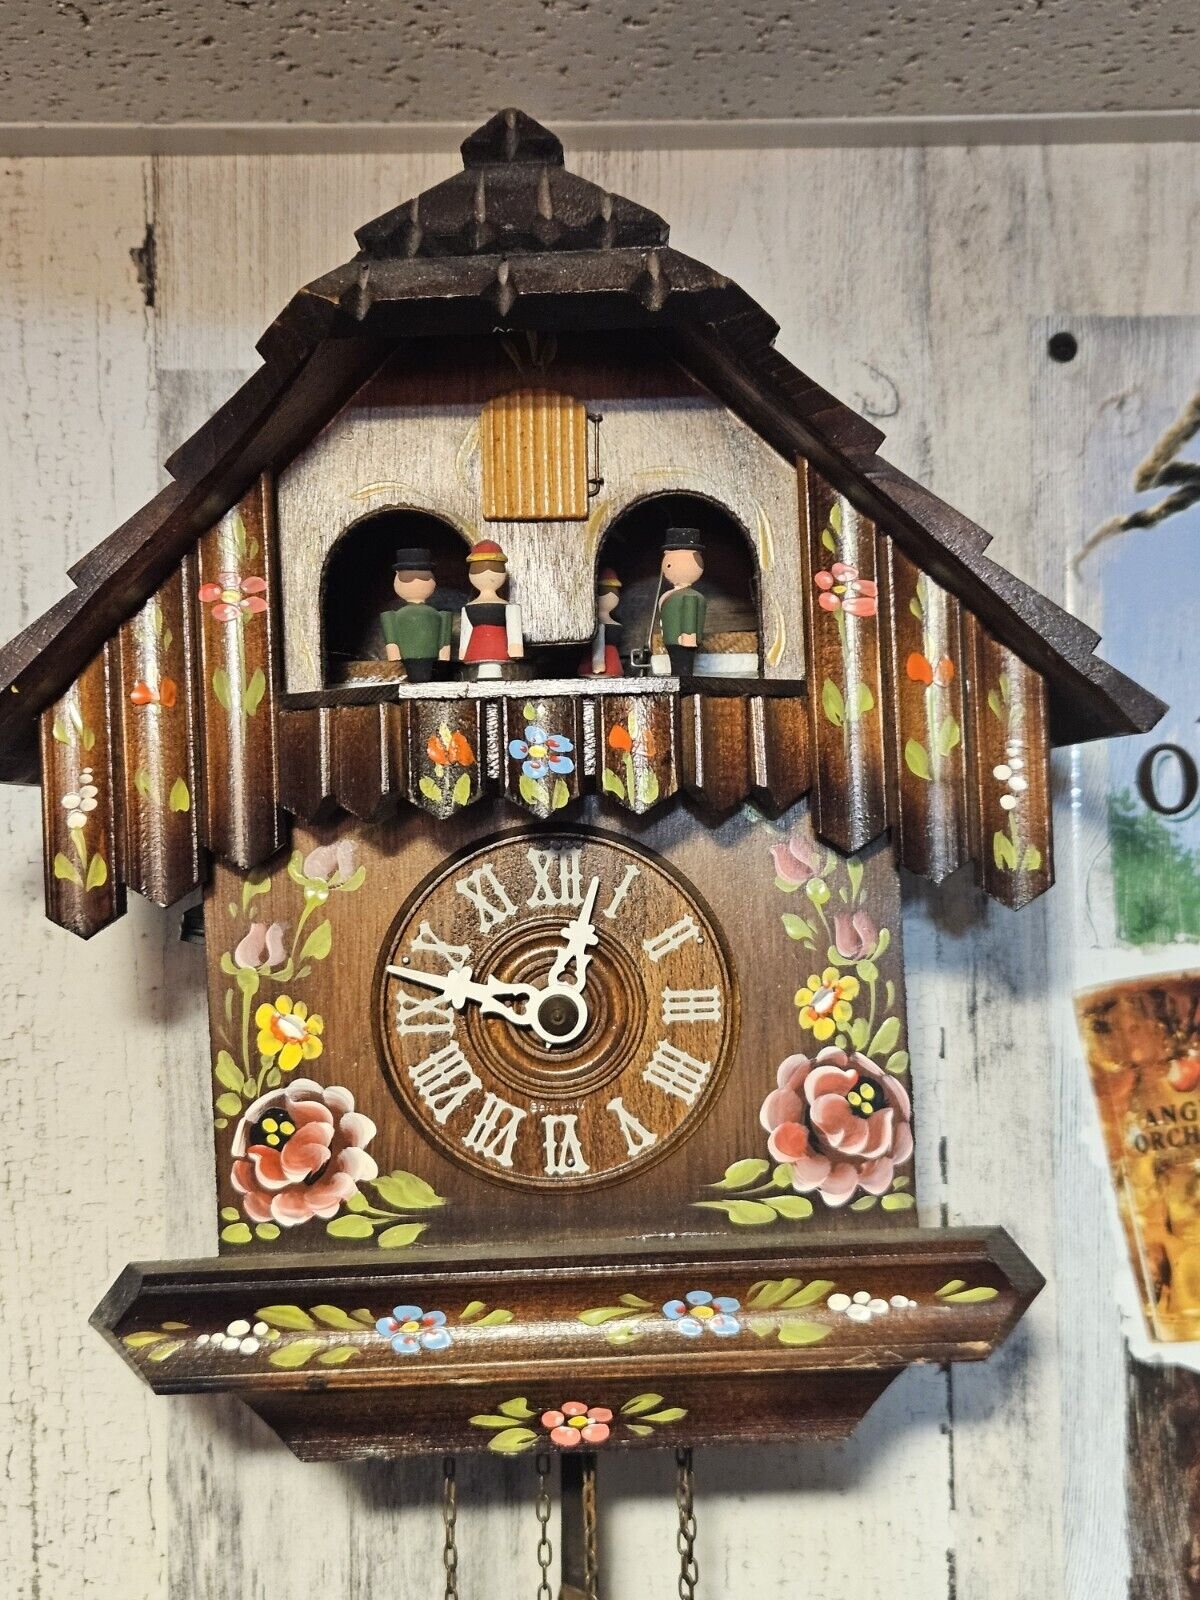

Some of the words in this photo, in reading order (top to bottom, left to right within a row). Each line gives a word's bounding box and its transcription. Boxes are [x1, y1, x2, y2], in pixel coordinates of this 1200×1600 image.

[455, 863, 518, 933] XI
[527, 847, 585, 908] XII
[603, 864, 640, 919] I
[411, 920, 473, 970] X
[643, 914, 701, 962] II
[396, 989, 456, 1037] IX
[661, 984, 722, 1025] III
[408, 1040, 483, 1125] VIII
[643, 1039, 711, 1105] IIII
[461, 1092, 527, 1167] VII
[542, 1114, 590, 1175] VI
[606, 1097, 657, 1157] V
